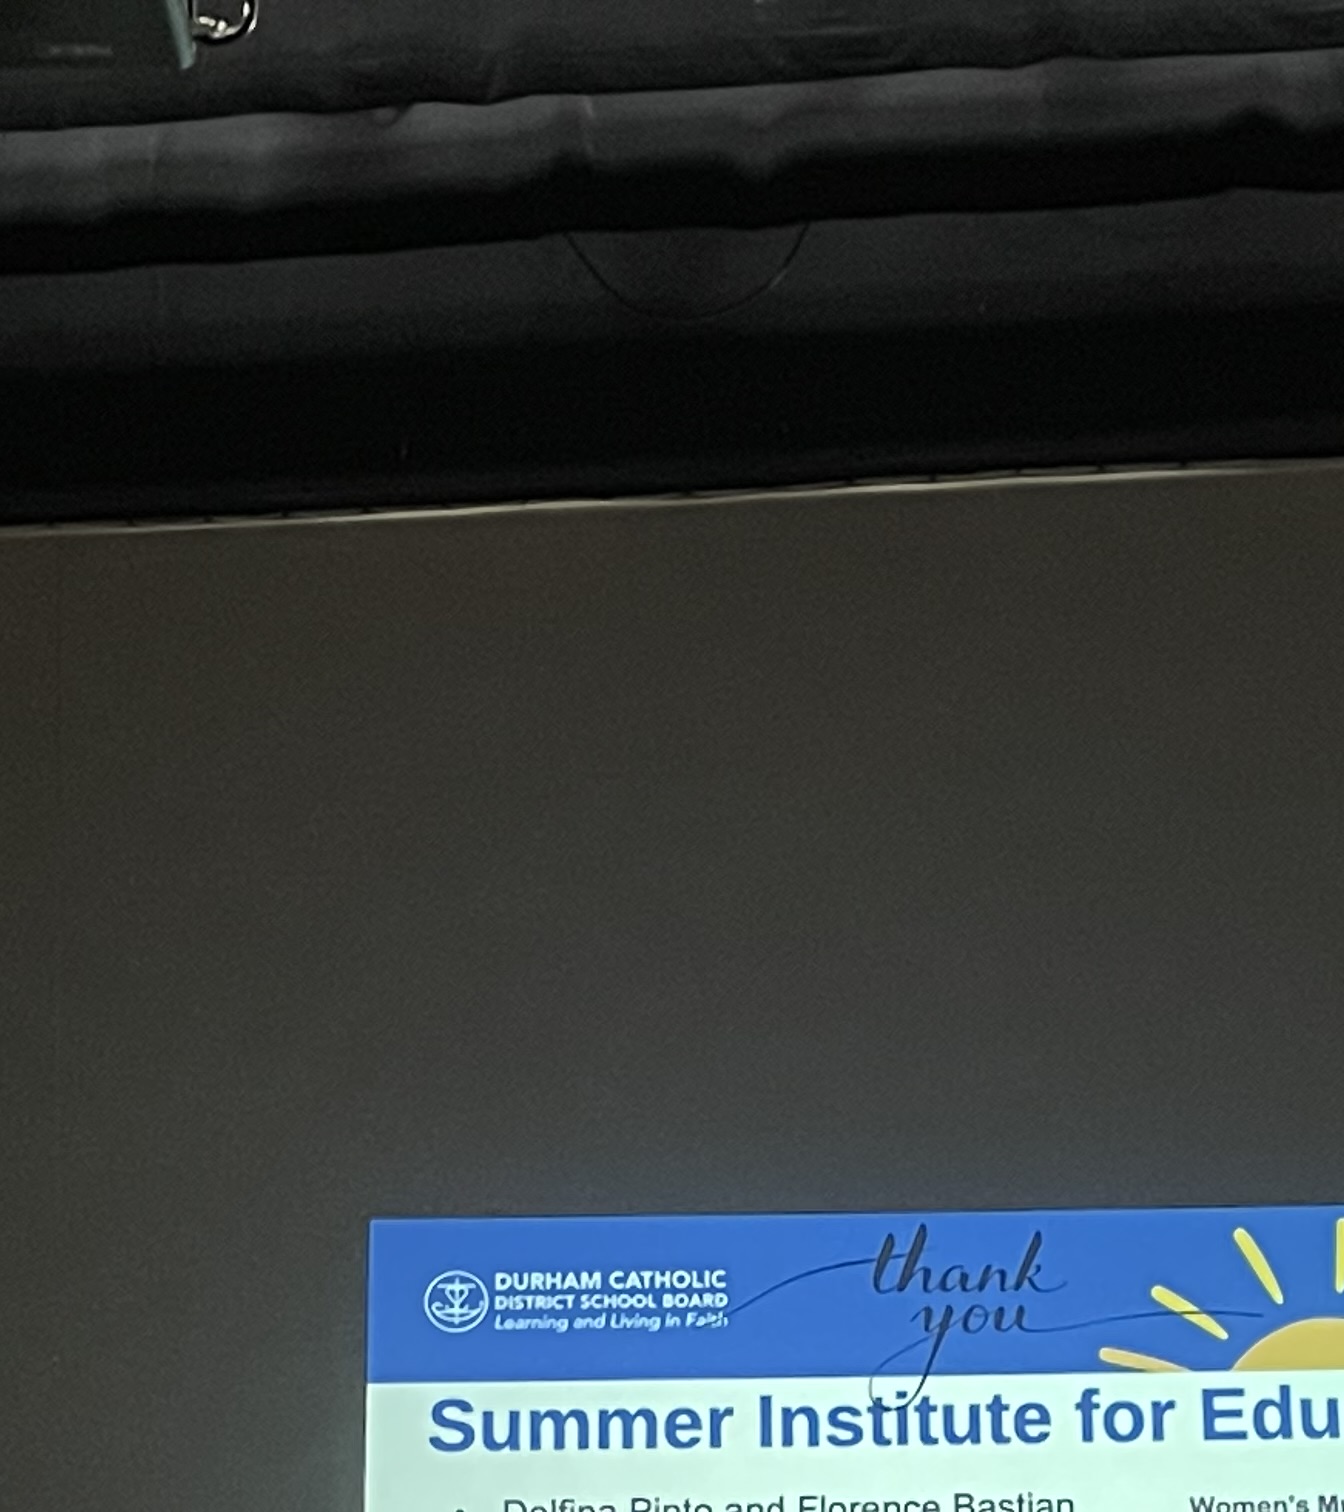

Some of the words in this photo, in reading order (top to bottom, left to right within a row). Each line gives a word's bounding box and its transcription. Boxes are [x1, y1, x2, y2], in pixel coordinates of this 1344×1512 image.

[494, 1271, 602, 1291] DURHAM
[608, 1269, 727, 1290] CATHOLIC
[872, 1222, 1068, 1294] thank
[494, 1293, 576, 1311] DISTRICT
[580, 1292, 657, 1310] SCHOOL
[662, 1291, 729, 1309] BOARD
[494, 1313, 569, 1333] Learning
[573, 1312, 606, 1329] and
[610, 1311, 661, 1332] Living
[869, 1303, 1032, 1411] you
[429, 1396, 734, 1453] Summer
[760, 1390, 1051, 1448] Institute
[1075, 1387, 1176, 1442] for
